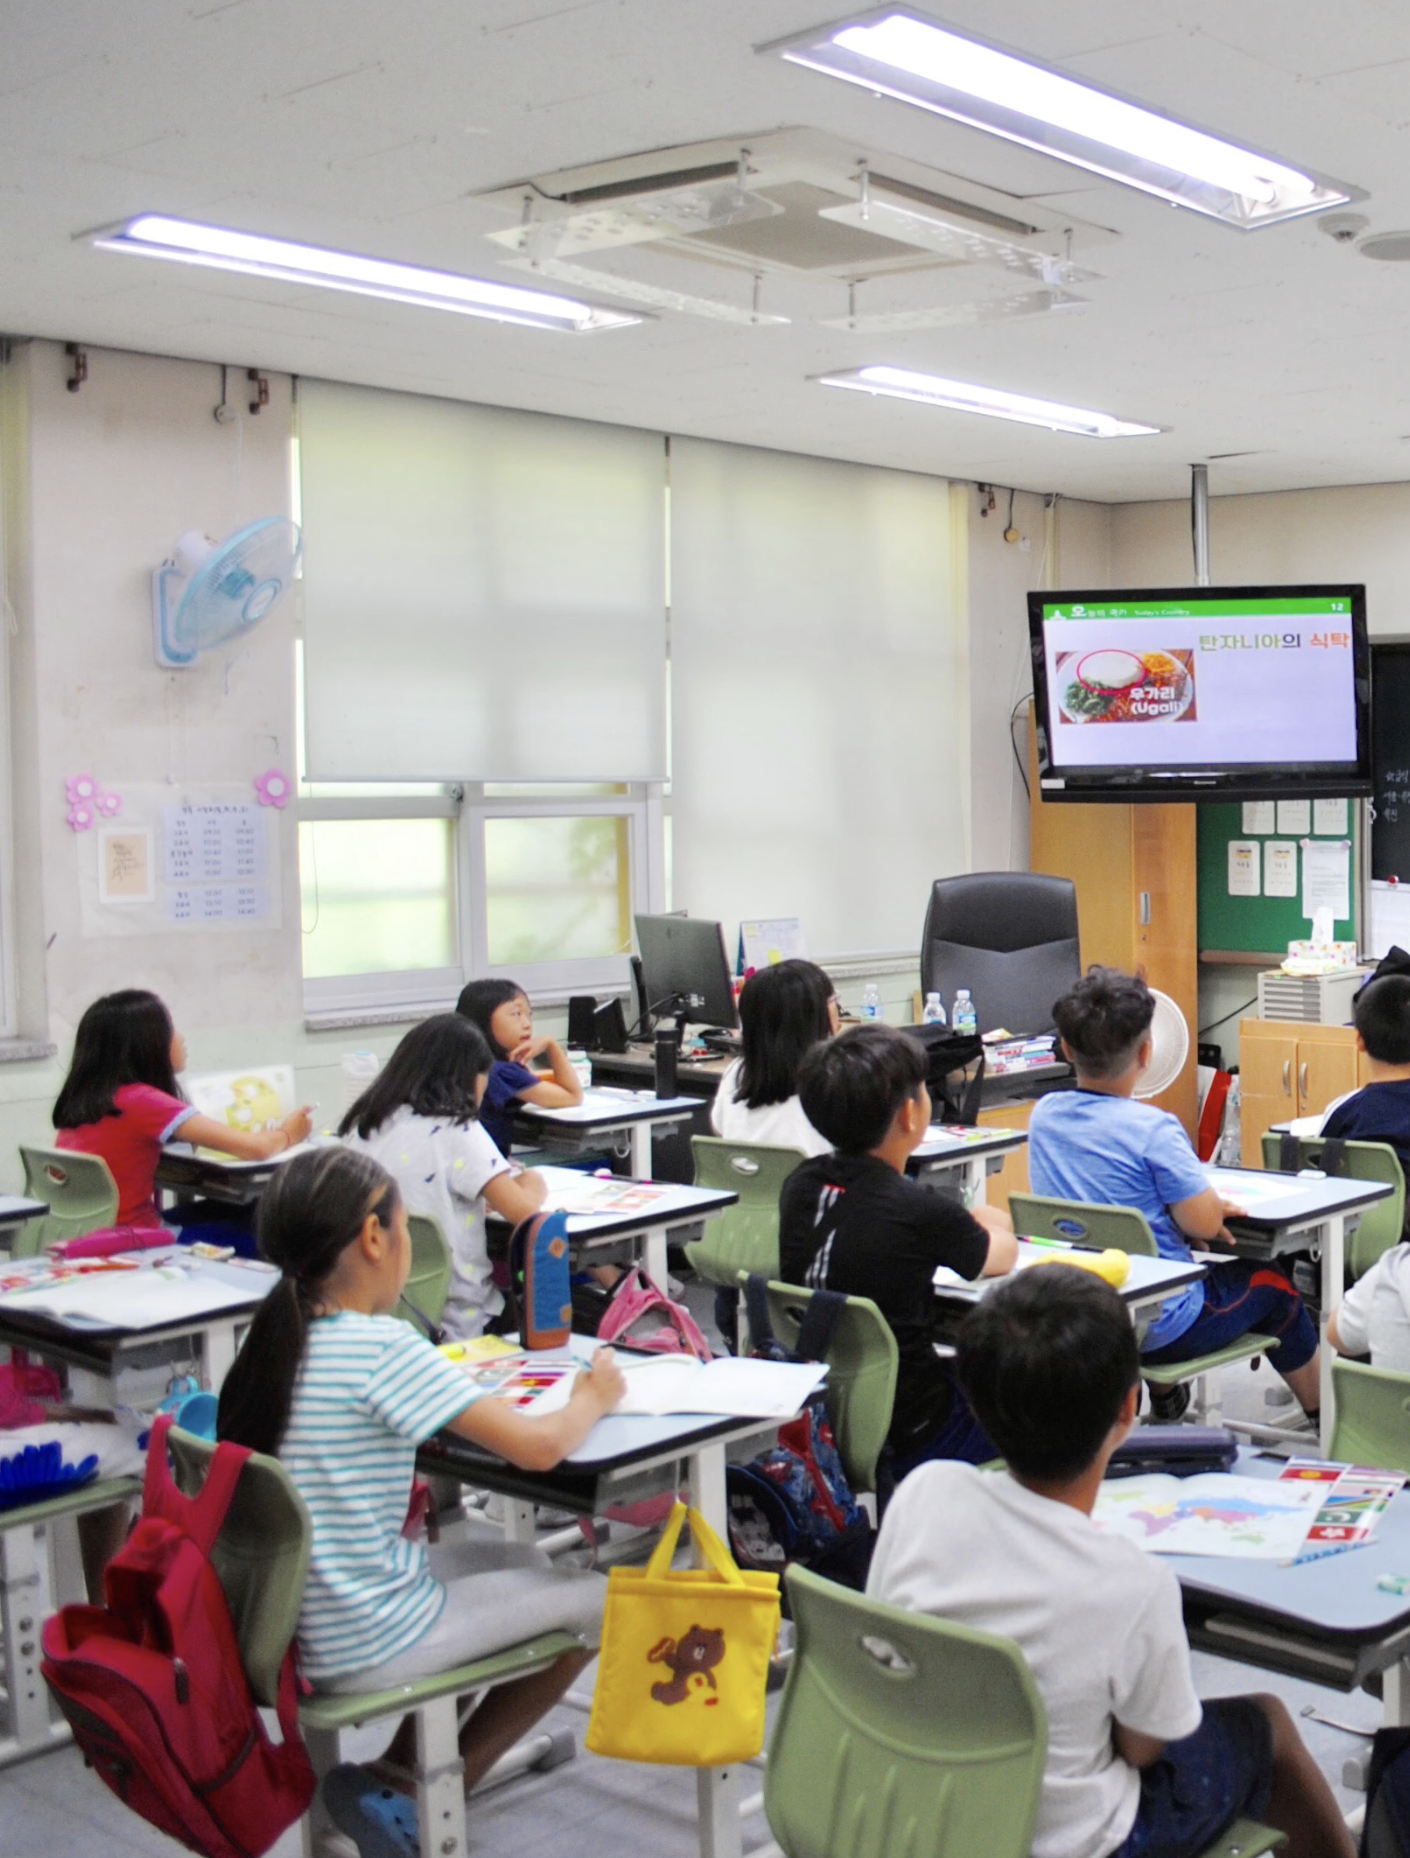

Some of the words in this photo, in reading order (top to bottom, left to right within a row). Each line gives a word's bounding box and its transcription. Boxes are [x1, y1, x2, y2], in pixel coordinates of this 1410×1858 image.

[1330, 602, 1344, 612] 12
[1199, 633, 1301, 651] 탄자니아의
[1309, 631, 1351, 648] 식탁
[1130, 687, 1175, 700] 우가리
[1131, 701, 1183, 716] (Ugali)
